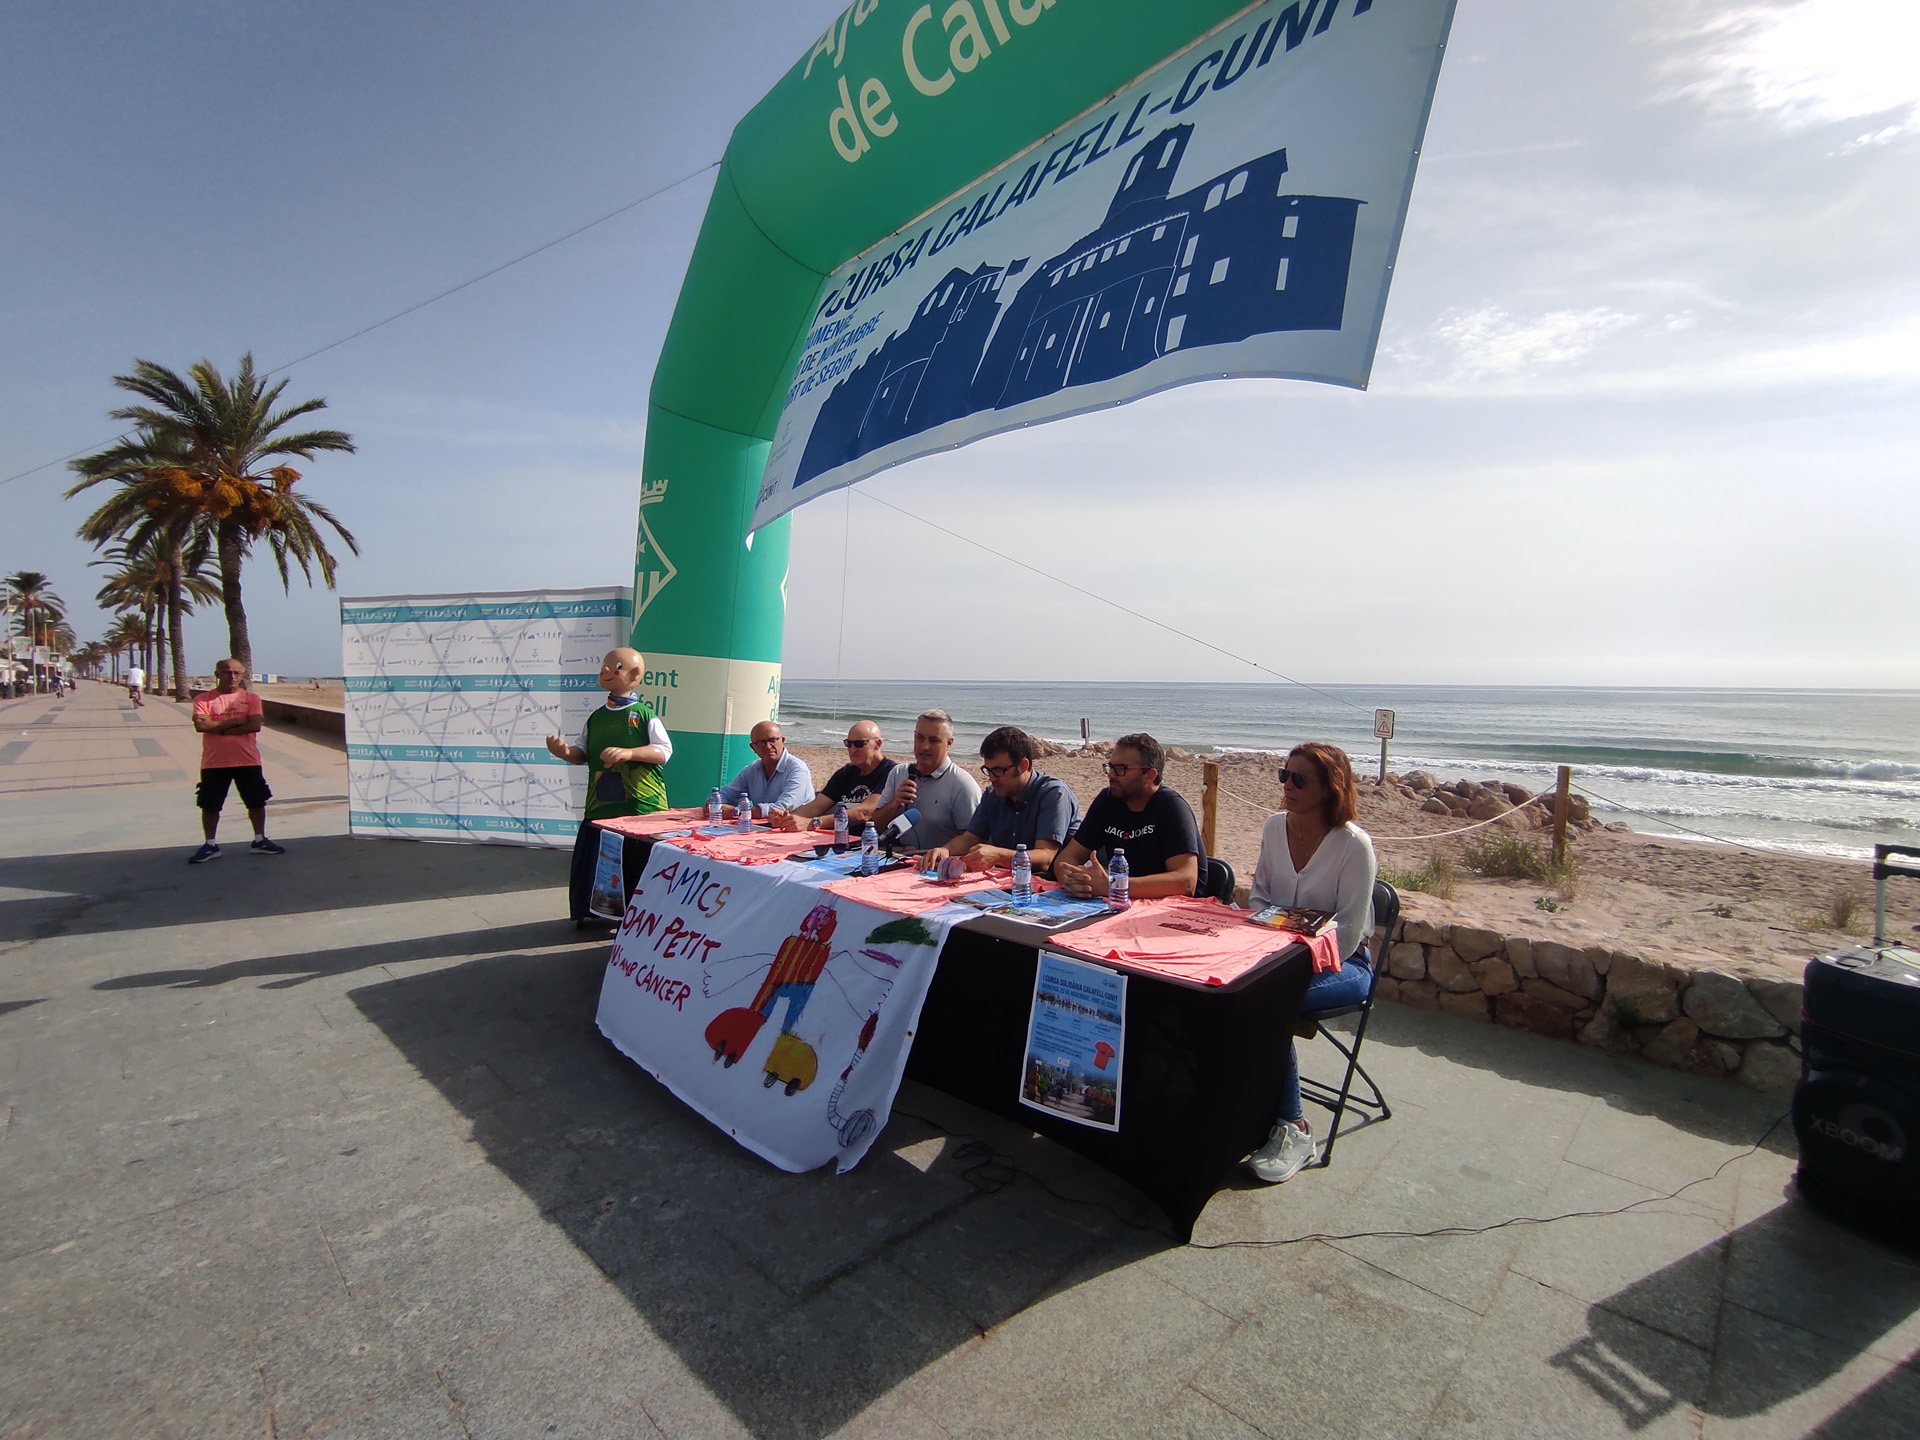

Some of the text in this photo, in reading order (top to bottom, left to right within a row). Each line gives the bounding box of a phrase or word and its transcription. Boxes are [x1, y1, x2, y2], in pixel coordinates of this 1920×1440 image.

[829, 74, 899, 163] de
[824, 226, 928, 318] CURSA
[799, 371, 820, 398] DE
[815, 348, 858, 388] SEGUR
[801, 350, 821, 376] DE
[640, 669, 679, 688] ent
[651, 861, 732, 919] AMICS
[653, 916, 722, 963] PETIT
[1810, 1113, 1903, 1162] XBOOM
